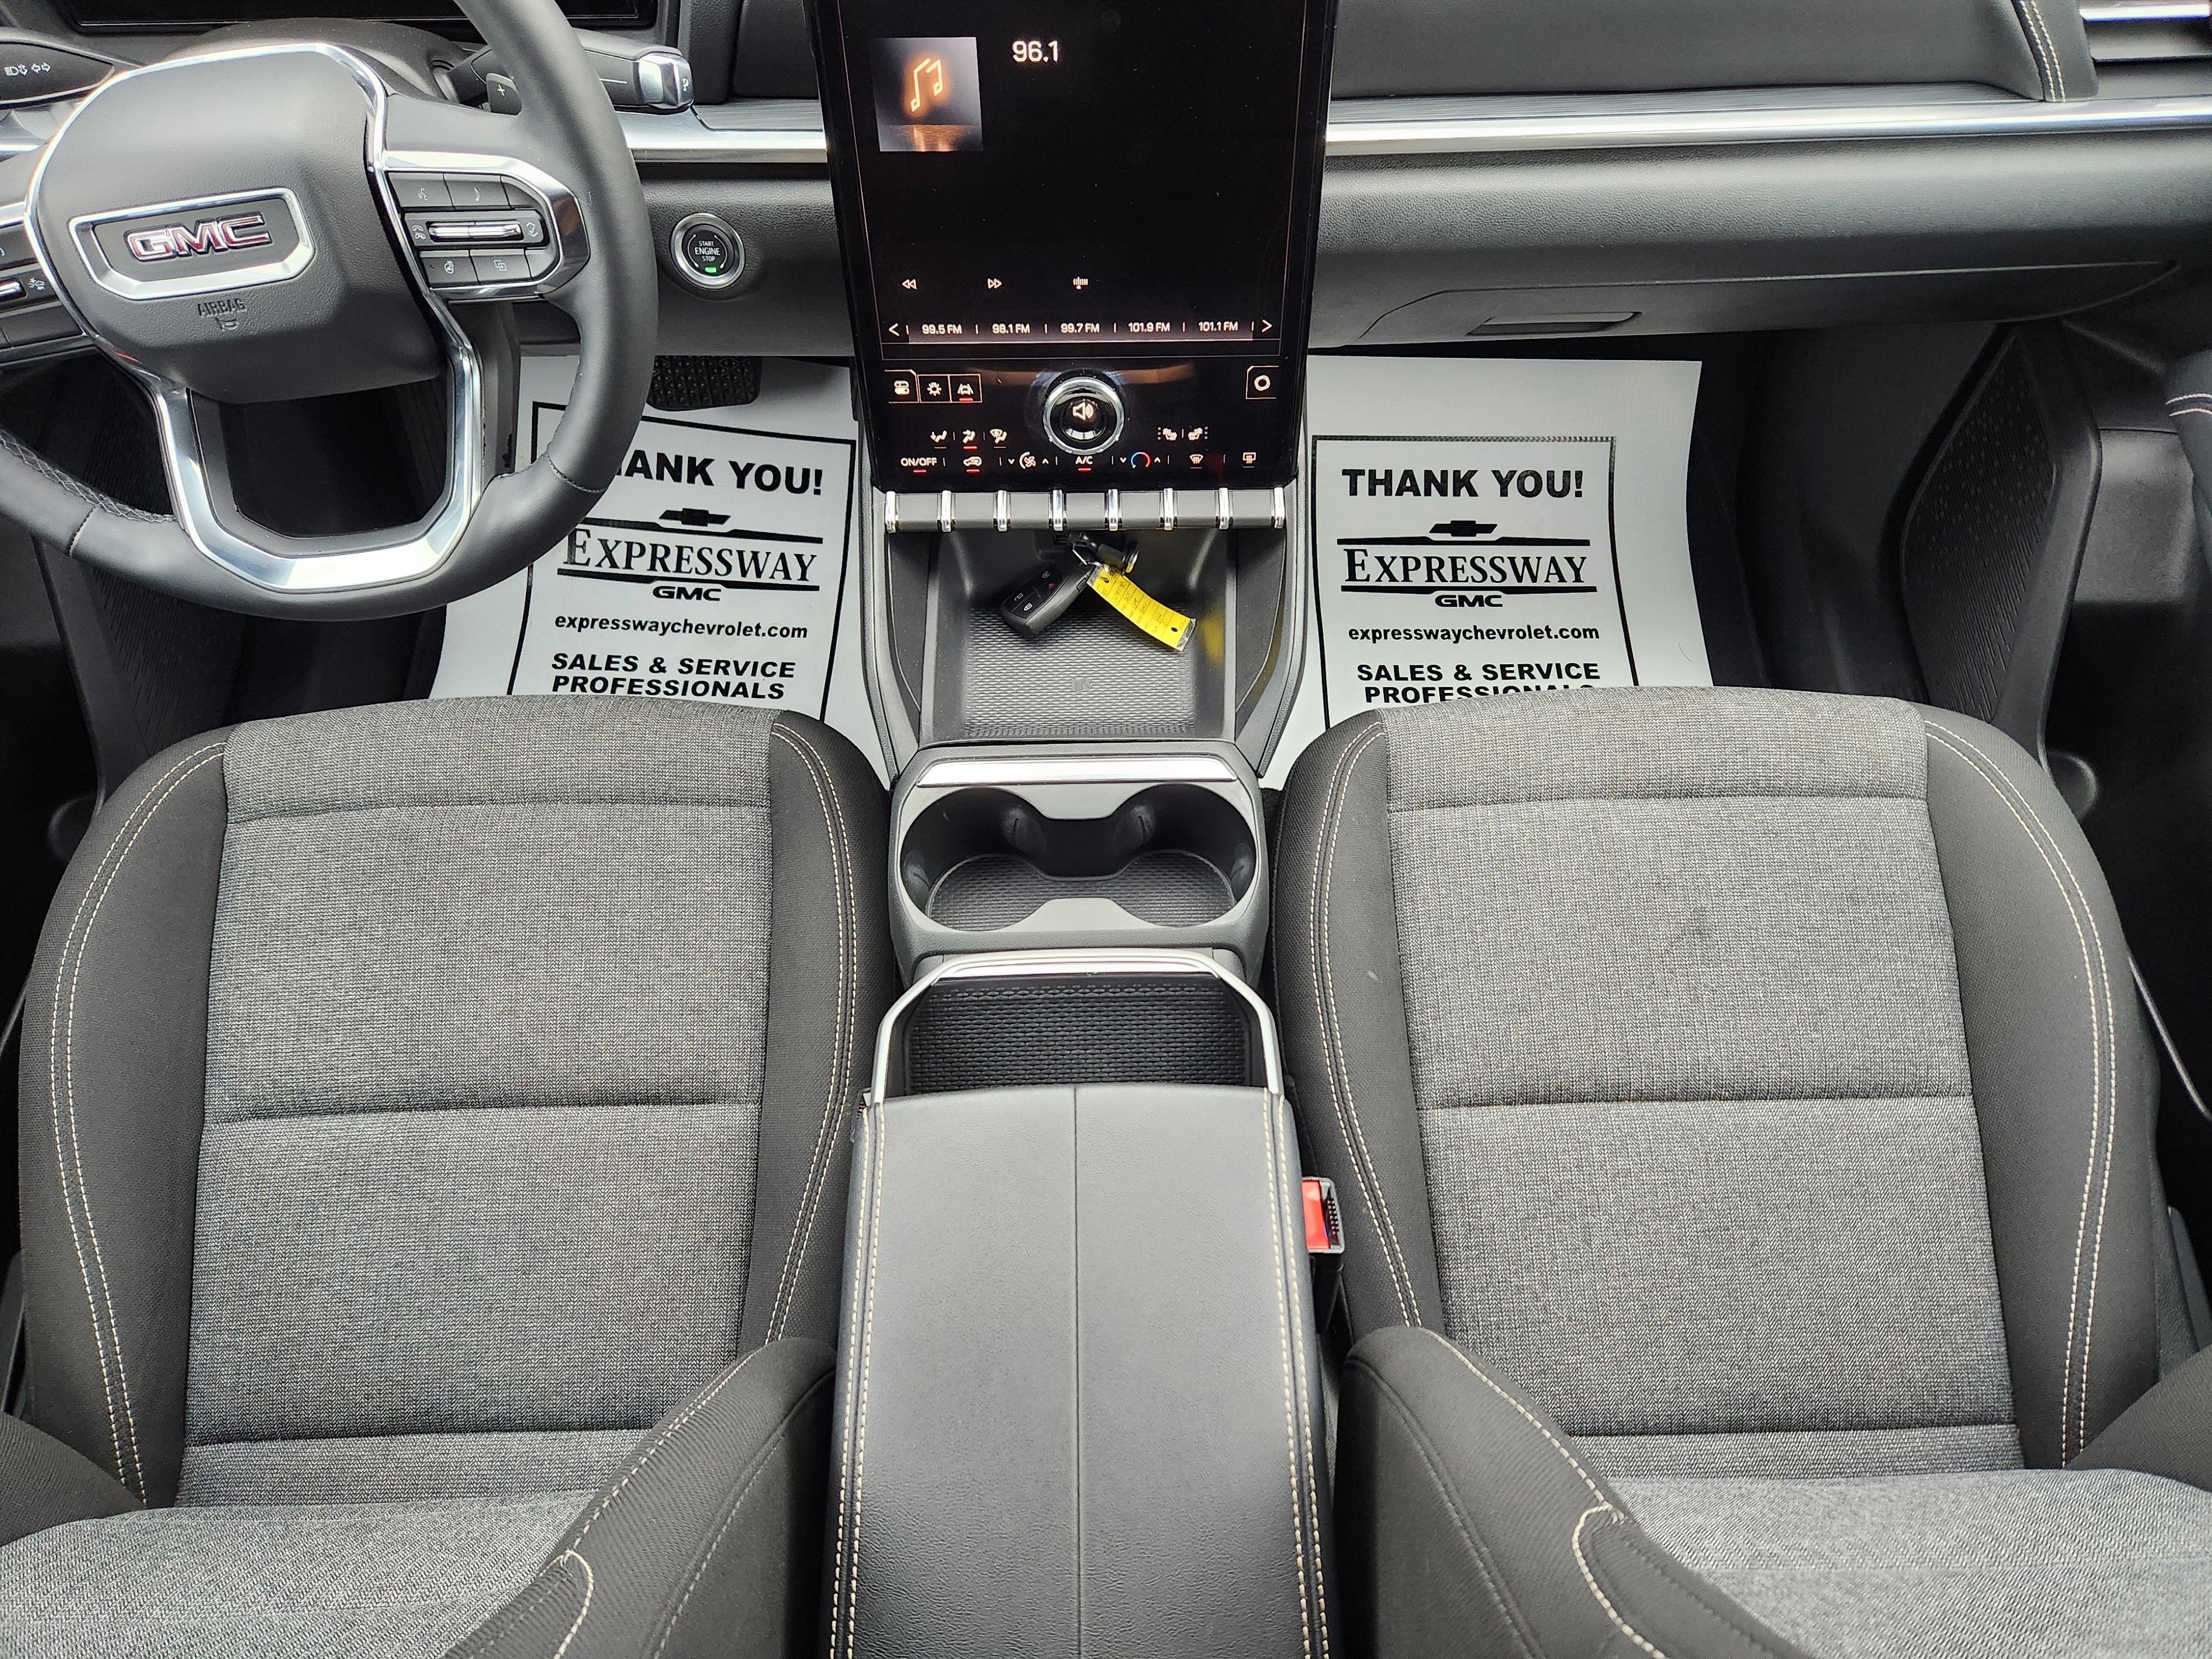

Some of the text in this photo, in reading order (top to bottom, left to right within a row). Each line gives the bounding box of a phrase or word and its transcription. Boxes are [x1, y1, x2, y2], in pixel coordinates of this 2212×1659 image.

[1013, 40, 1057, 62] 96.1
[124, 211, 273, 262] GMC
[695, 247, 721, 256] ENGINE
[197, 298, 248, 317] AIRBAG
[922, 324, 962, 334] 99.5 FM
[993, 324, 1030, 333] 98.1 FM
[1061, 323, 1099, 333] 99.7 FM
[1129, 322, 1170, 332] 101.9 FM
[1199, 321, 1238, 331] 101.1 FM
[901, 457, 937, 466] ON/OFF
[1075, 456, 1093, 465] A/C
[616, 449, 822, 495] ANK YOU!
[1342, 469, 1583, 498] THANK YOU!
[563, 528, 817, 582] EXPRESSWAY
[1344, 549, 1587, 583] EXPRESSWAY
[653, 586, 721, 601] GMC
[1434, 594, 1503, 607] GMC
[555, 616, 807, 638] expresswaychevrolet.com
[1349, 625, 1599, 644] expresswaychevrolet.com
[552, 653, 795, 677] SALES & SERVICE
[1358, 663, 1600, 681] SALES & SERVICE
[552, 676, 784, 699] PROFESSIONALS
